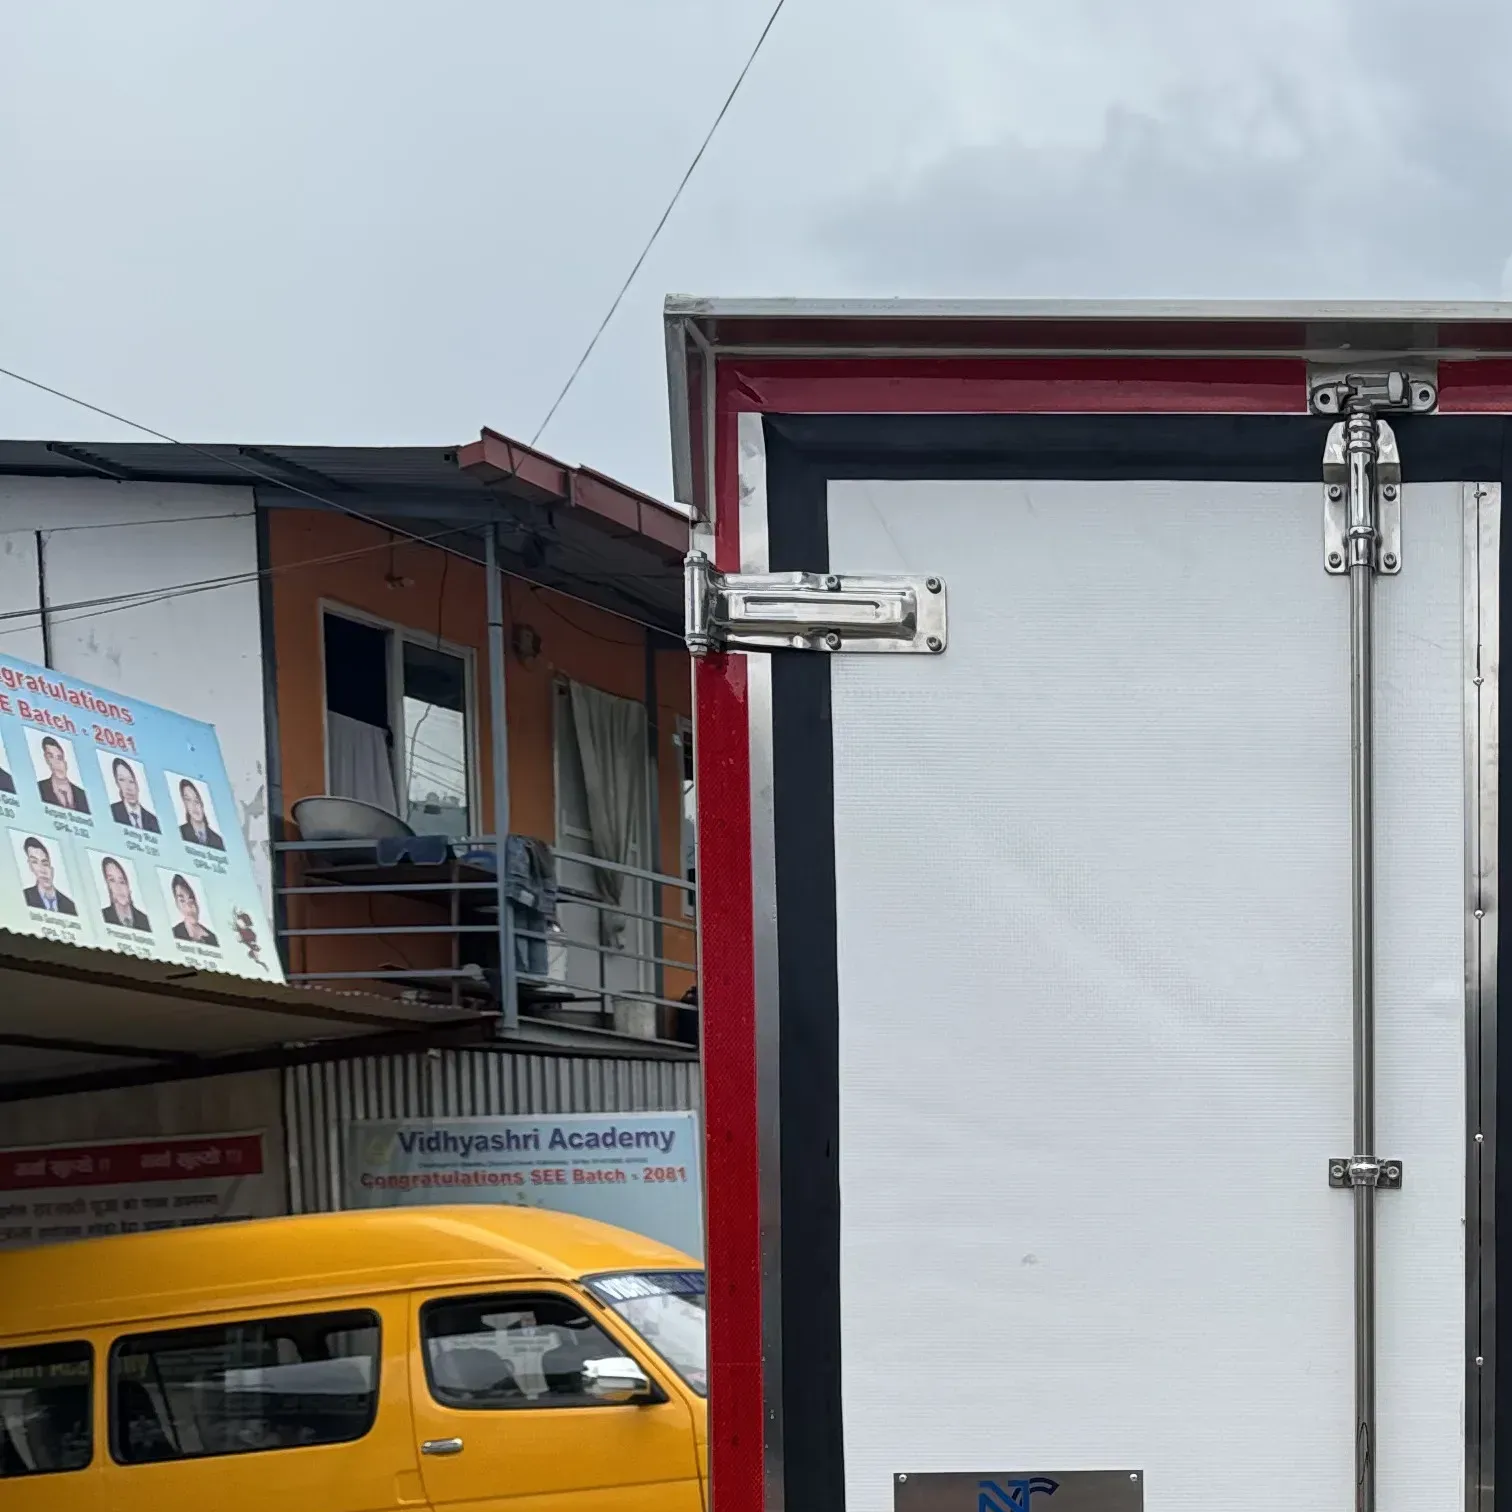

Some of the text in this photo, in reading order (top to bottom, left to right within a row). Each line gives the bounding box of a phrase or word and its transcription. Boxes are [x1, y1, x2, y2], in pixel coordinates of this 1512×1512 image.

[0, 666, 135, 725] gratulations
[16, 699, 77, 736] Batch
[92, 724, 138, 756] 2081
[397, 1126, 676, 1158] Vidhyashri Academy
[361, 1169, 526, 1192] Congratulations
[530, 1169, 568, 1185] SEE
[572, 1168, 627, 1184] Batch
[643, 1166, 688, 1183] 2081
